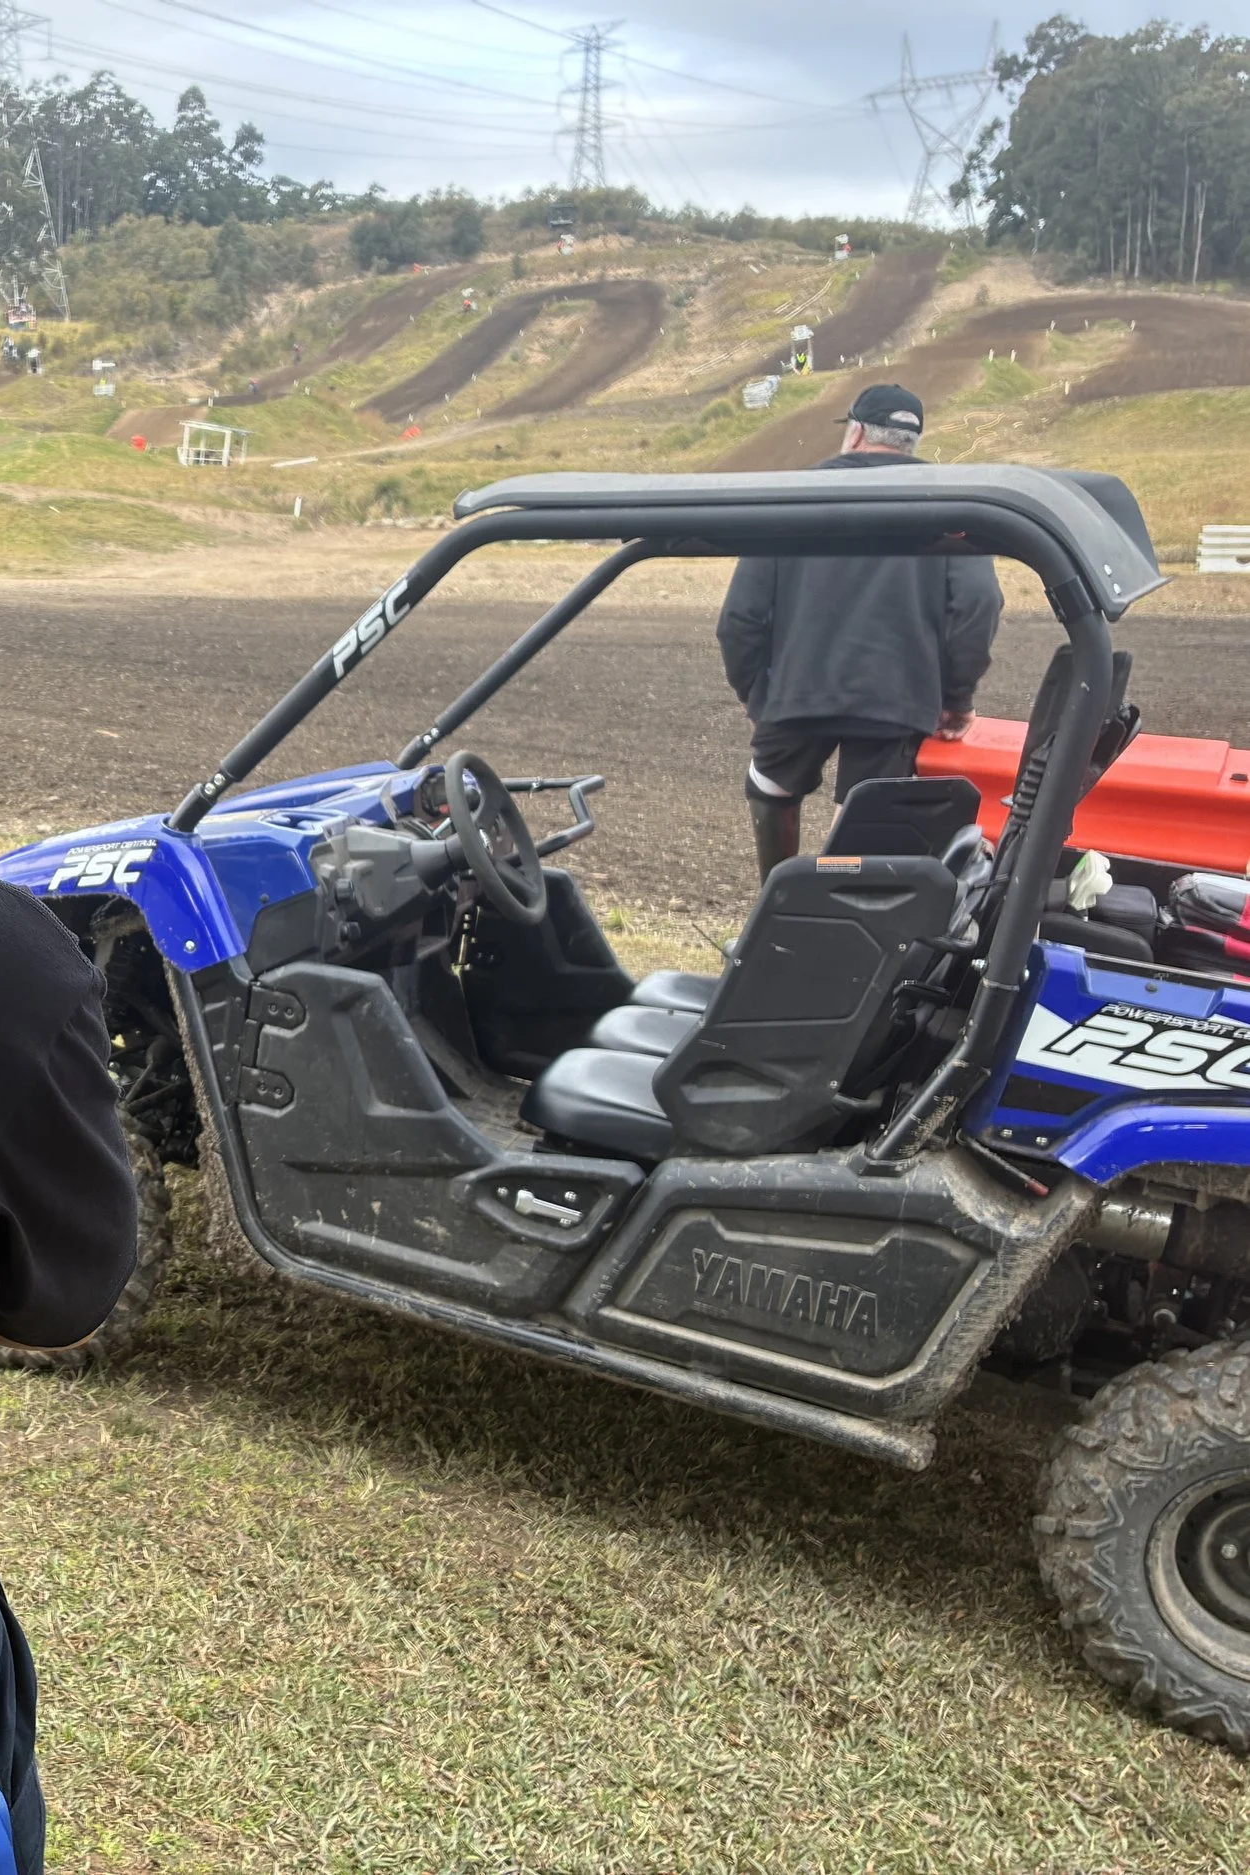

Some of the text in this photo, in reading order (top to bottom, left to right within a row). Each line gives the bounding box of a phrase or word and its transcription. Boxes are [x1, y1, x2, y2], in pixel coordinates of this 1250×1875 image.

[332, 576, 410, 678] PSC
[48, 849, 153, 891] PSC
[1101, 1003, 1234, 1035] POWERSPORT
[693, 1248, 878, 1337] YAMAHA
